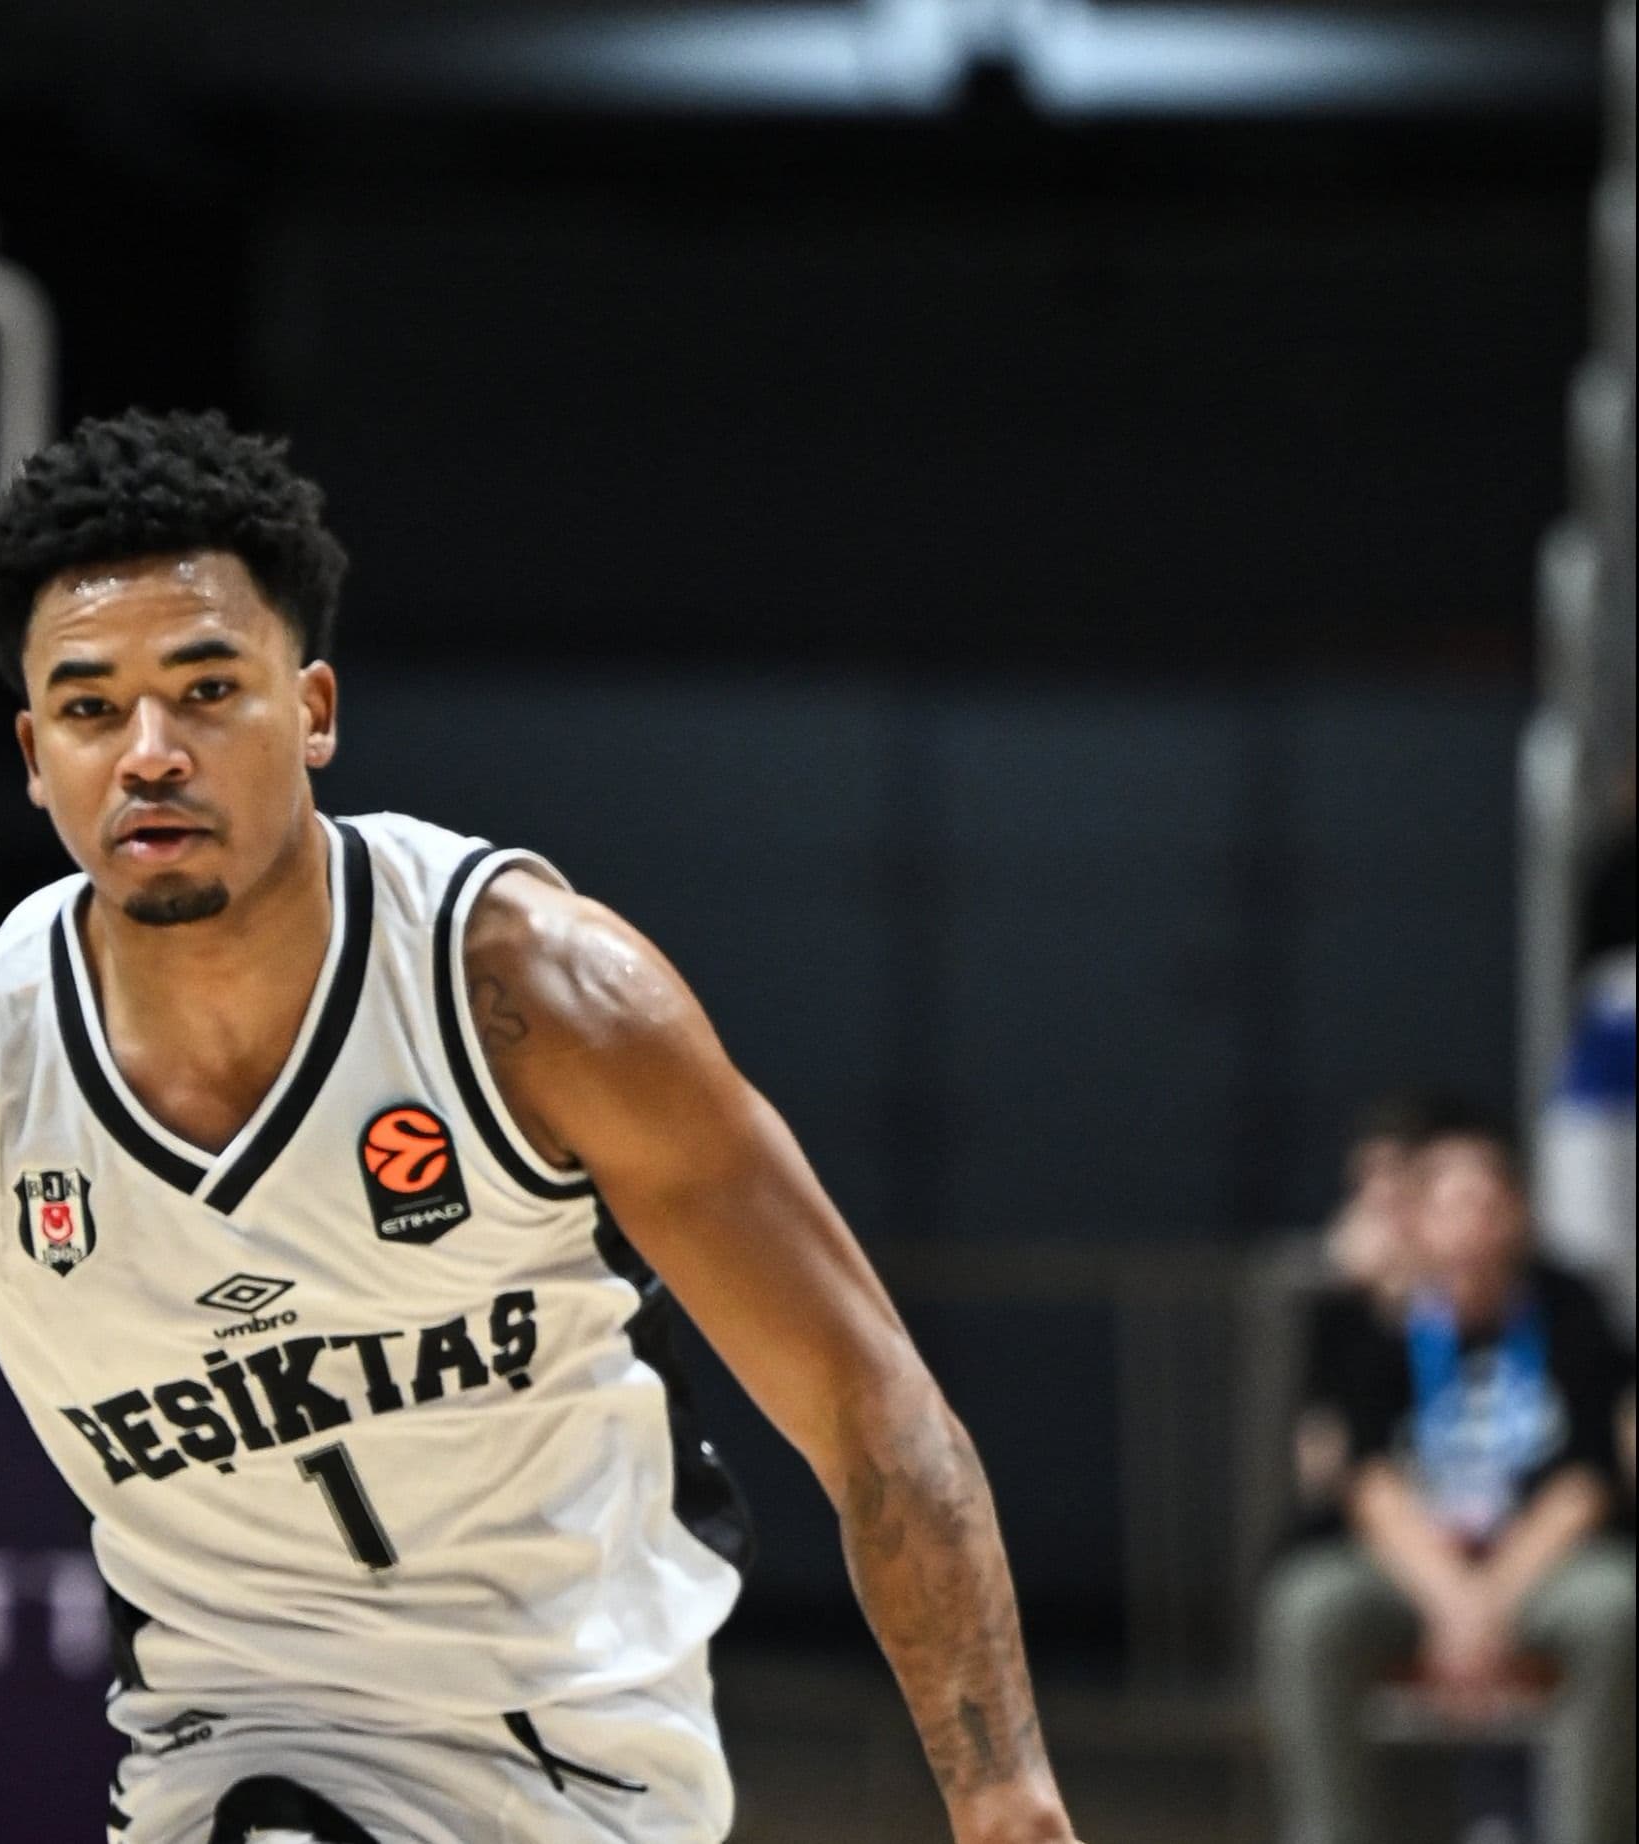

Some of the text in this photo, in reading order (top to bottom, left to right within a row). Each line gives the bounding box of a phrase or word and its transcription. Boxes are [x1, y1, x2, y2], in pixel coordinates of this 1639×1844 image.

[26, 1176, 80, 1199] BJK
[381, 1202, 464, 1235] ETIHAD
[213, 1309, 298, 1340] umbro
[294, 1440, 399, 1573] 1
